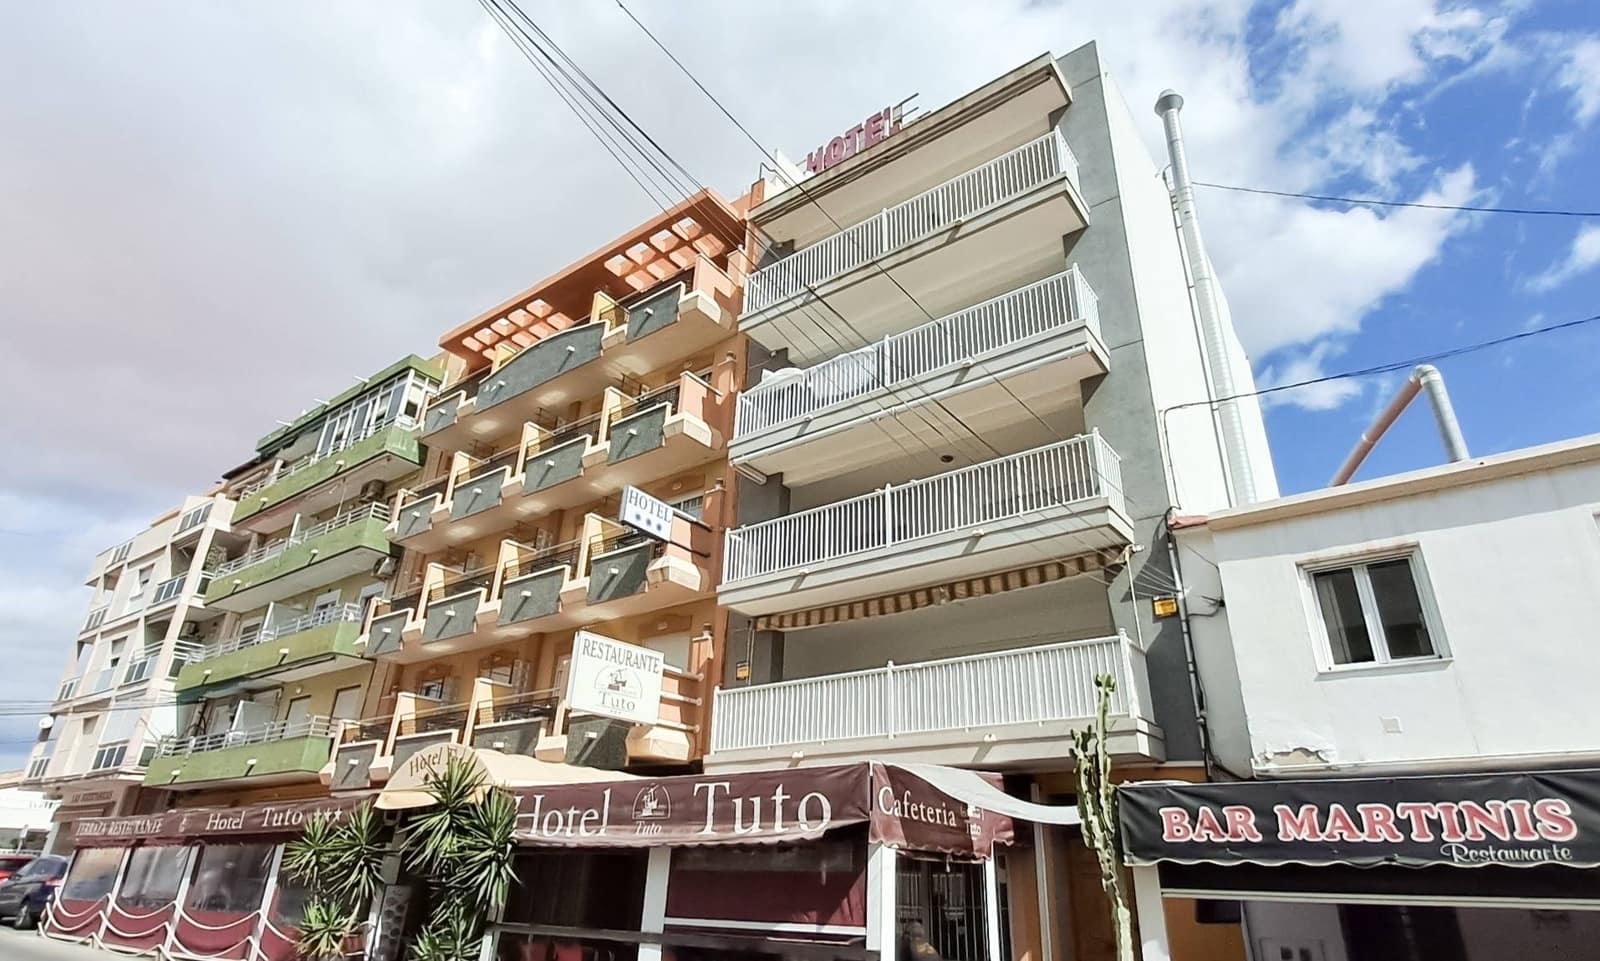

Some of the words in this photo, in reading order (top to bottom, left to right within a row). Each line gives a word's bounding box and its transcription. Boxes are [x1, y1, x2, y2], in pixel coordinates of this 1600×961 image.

[629, 489, 671, 523] HOTEL
[582, 638, 660, 674] RESTAURANTE
[599, 691, 636, 712] Tuto
[205, 810, 246, 831] Hotel
[261, 806, 304, 828] Tuto
[510, 788, 611, 838] Hotel
[693, 781, 832, 835] Tuto
[878, 786, 957, 828] Cafeteria
[1159, 805, 1263, 843] BAR
[1273, 798, 1578, 843] MARTINIS
[635, 820, 662, 836] Tuto
